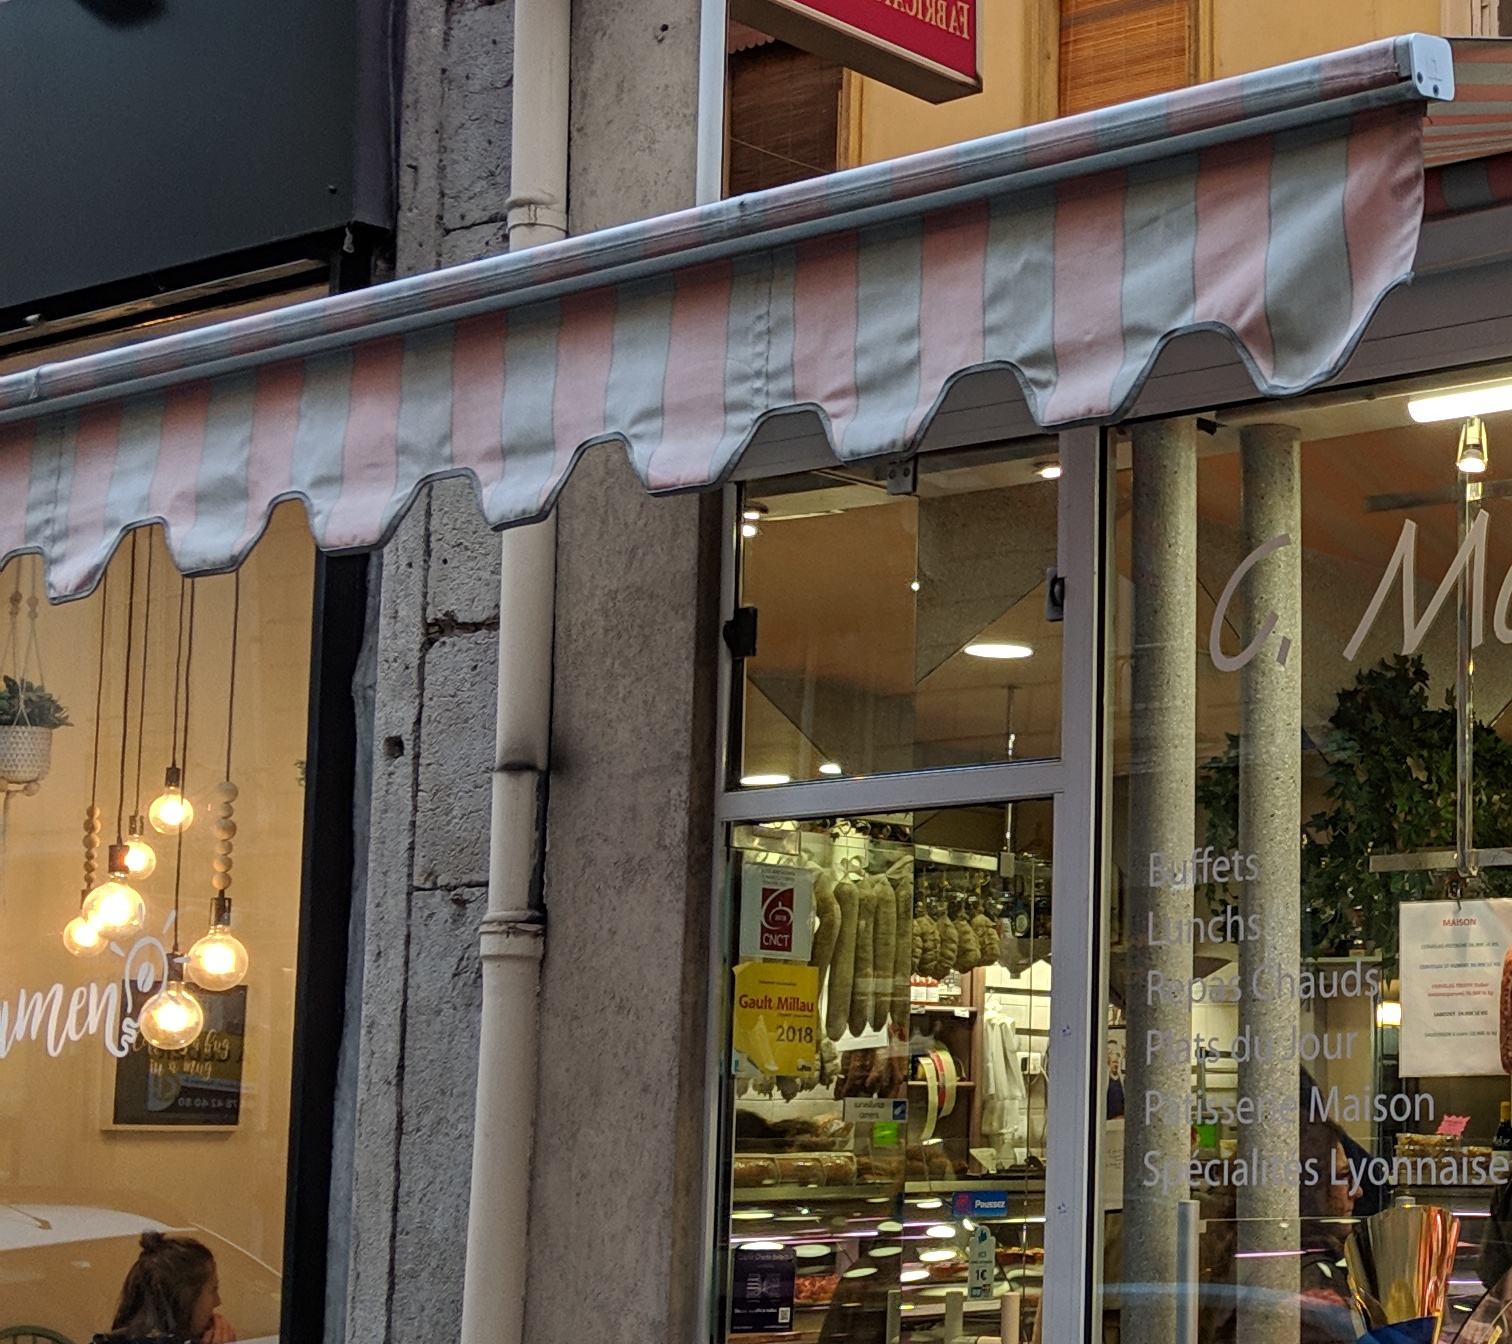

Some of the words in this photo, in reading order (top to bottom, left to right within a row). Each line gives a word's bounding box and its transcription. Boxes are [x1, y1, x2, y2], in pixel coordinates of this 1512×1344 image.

[1147, 846, 1260, 888] Buffets
[762, 933, 790, 947] CNCT
[1147, 904, 1262, 946] Lunchs
[739, 994, 772, 1010] Gault
[777, 996, 814, 1013] Millau
[1146, 969, 1241, 1009] Repas
[1251, 960, 1380, 1001] Chauds
[776, 1025, 814, 1044] 2018
[1145, 1028, 1220, 1065] Plats
[1231, 1025, 1274, 1063] du
[1285, 1026, 1359, 1062] Jour
[1309, 1085, 1435, 1124] Maison
[1143, 1149, 1319, 1195] Spécialités
